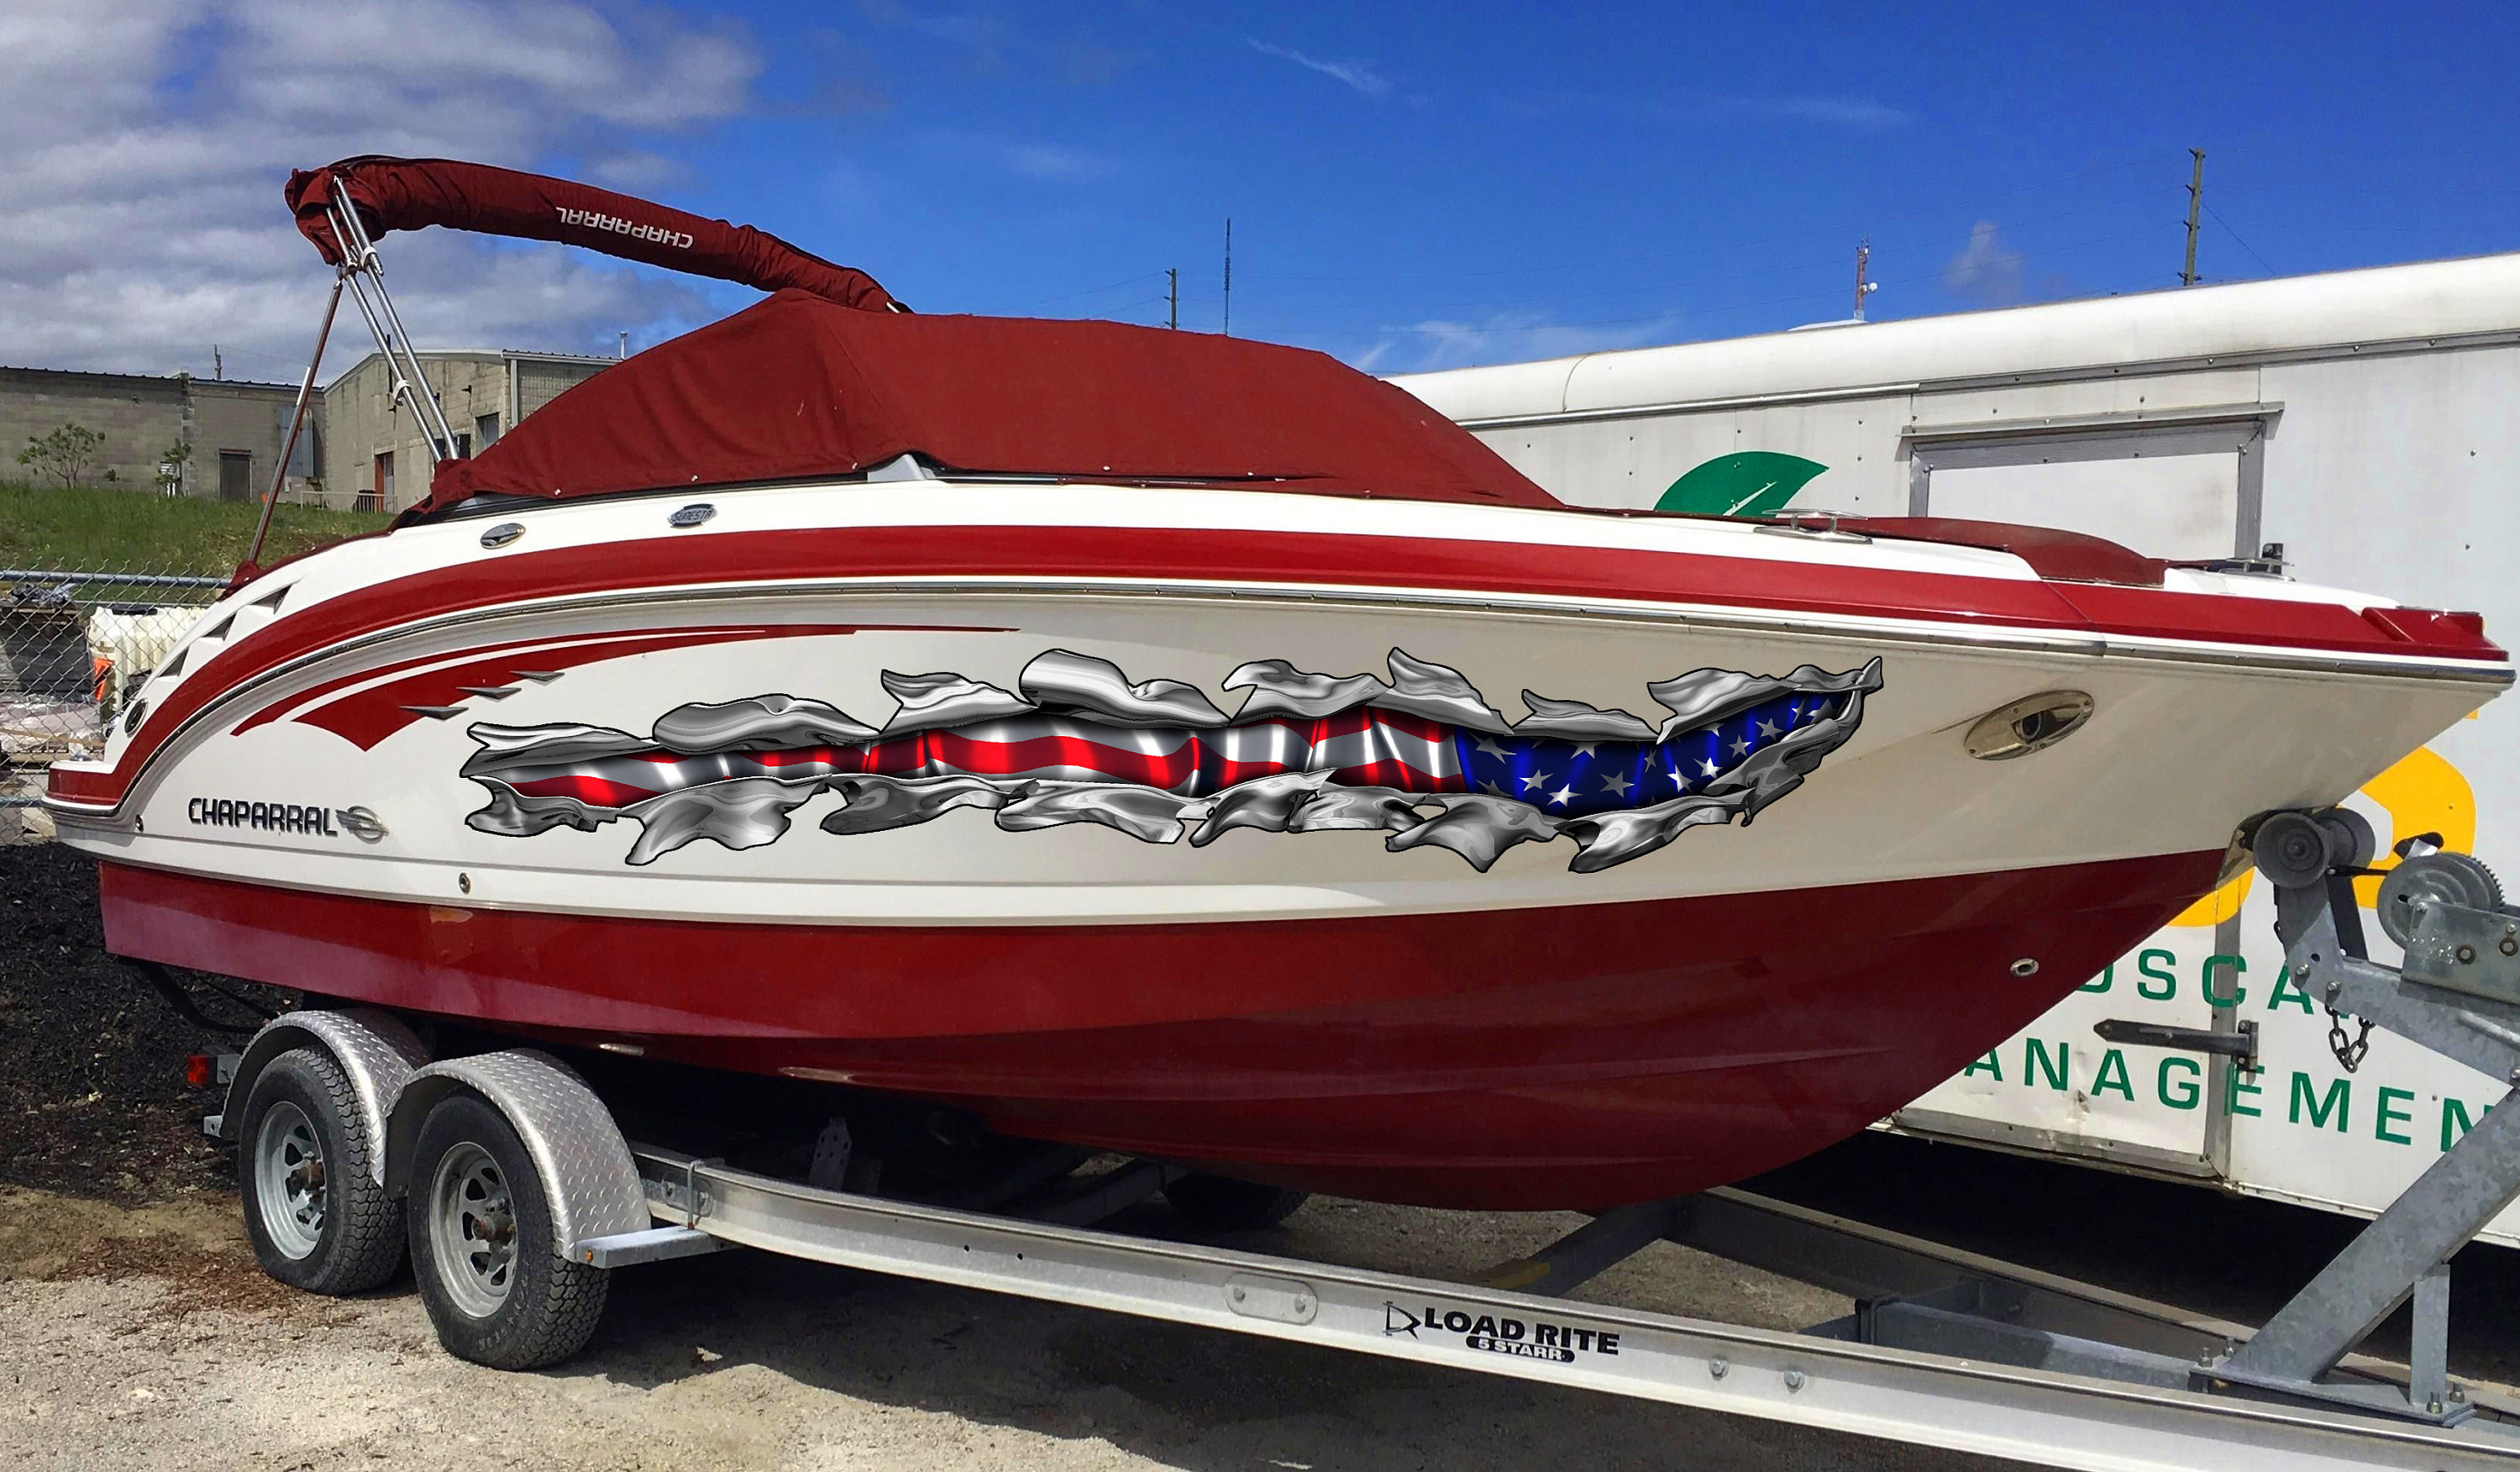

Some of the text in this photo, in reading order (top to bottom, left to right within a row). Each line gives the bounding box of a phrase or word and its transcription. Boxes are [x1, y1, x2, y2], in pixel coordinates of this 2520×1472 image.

[555, 206, 694, 250] CHAPARRAL
[188, 797, 339, 838] CHAPARRAL
[1425, 1306, 1620, 1356] LOAD RITE
[1478, 1338, 1563, 1360] 5 STARR
